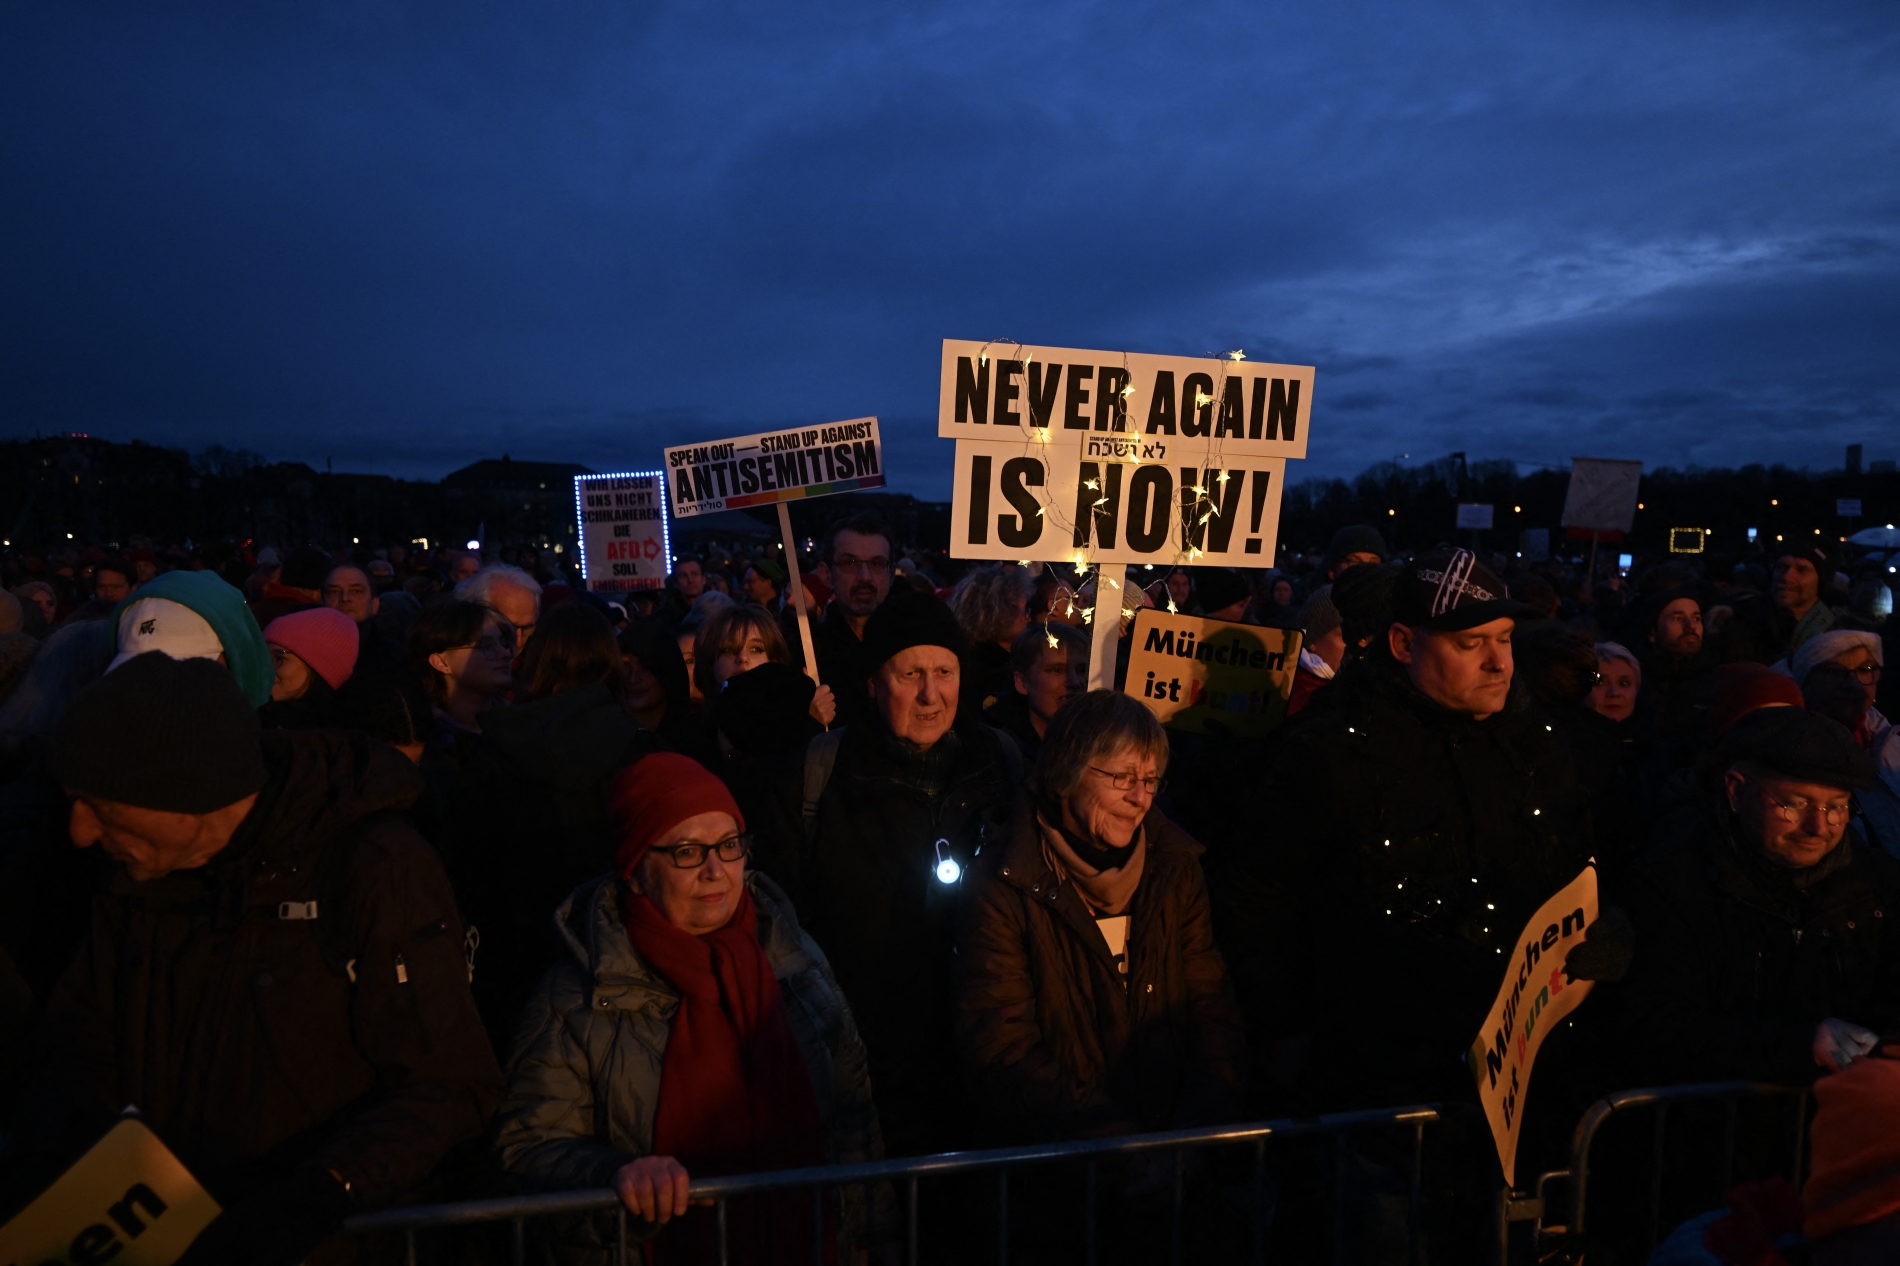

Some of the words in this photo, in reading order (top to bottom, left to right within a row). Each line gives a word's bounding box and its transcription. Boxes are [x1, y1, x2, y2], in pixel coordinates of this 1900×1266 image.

[954, 356, 1131, 431] NEVER
[1145, 370, 1301, 441] AGAIN
[670, 447, 710, 467] SPEAK
[711, 443, 735, 460] OUT
[760, 434, 801, 453] STAND
[802, 430, 819, 446] UP
[821, 422, 872, 444] AGAINST
[1142, 441, 1166, 460] לא
[585, 478, 609, 491] WIR
[611, 477, 653, 491] LASSEN
[676, 440, 879, 504] ANTISEMITISM
[587, 494, 612, 507] UNS
[615, 492, 653, 506] NICHT
[678, 501, 722, 514] סולידריות
[968, 455, 1045, 548] IS
[1073, 461, 1270, 554] NOW!
[614, 525, 631, 537] DIE
[607, 541, 640, 560] AFD
[592, 577, 661, 592] EMIGRIEREN!
[613, 563, 638, 576] SOLL
[1144, 628, 1286, 671] München
[1144, 671, 1181, 702] ist
[1189, 679, 1271, 714] bunt!
[1487, 907, 1585, 1090] München
[1503, 1064, 1519, 1131] ist
[1517, 966, 1576, 1069] bunt
